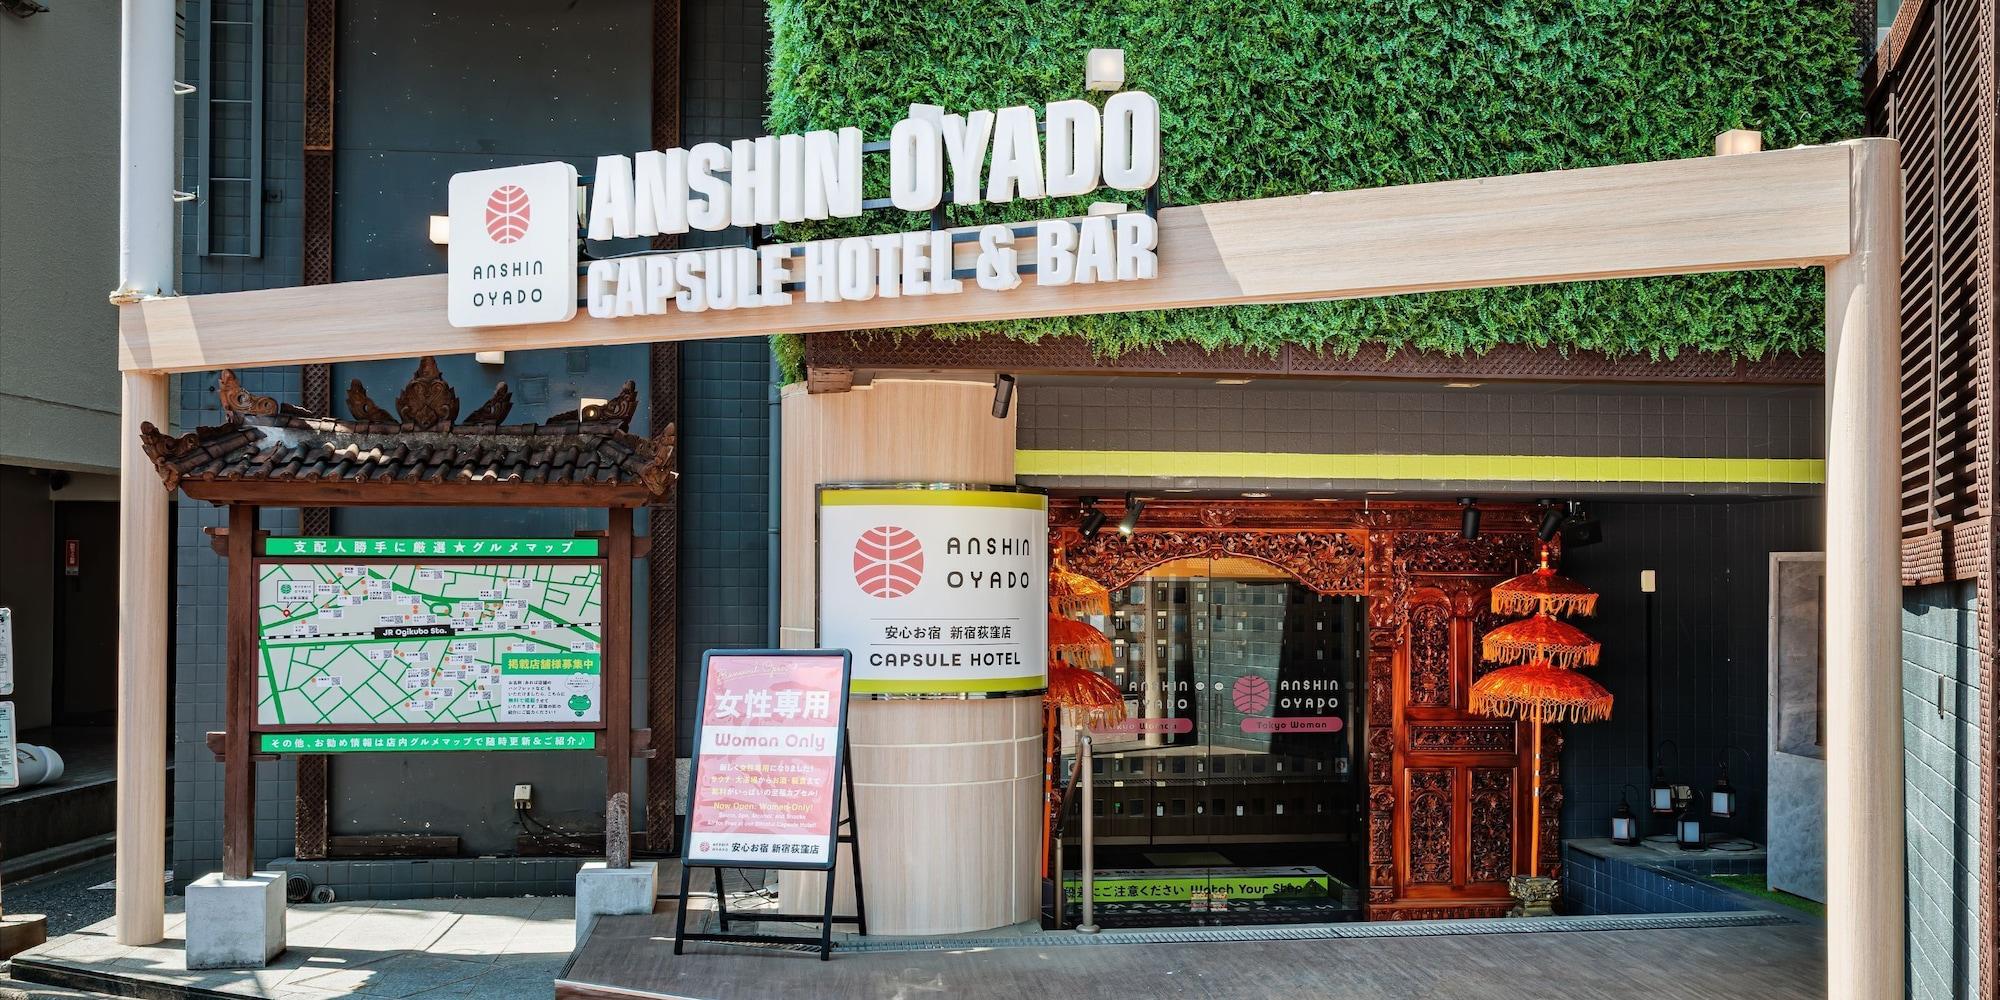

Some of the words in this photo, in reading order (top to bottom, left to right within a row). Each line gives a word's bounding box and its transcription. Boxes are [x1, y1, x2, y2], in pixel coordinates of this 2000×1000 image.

[588, 126, 863, 241] ANSHIN
[889, 90, 1160, 212] OYADO
[472, 260, 543, 281] ANSHIN
[587, 244, 794, 319] CAPSULE
[805, 230, 963, 304] HOTEL
[976, 224, 1021, 292] &
[1036, 213, 1158, 287] BAR
[472, 287, 543, 307] OYADO
[947, 537, 1030, 556] ANSHIN
[947, 571, 1030, 589] OYADO
[383, 629, 394, 637] JR
[395, 628, 429, 638] Ogikubo
[430, 626, 447, 635] Sta.
[885, 625, 941, 640] 安心お宿
[950, 625, 1012, 640] 新宿荻窪店
[869, 653, 962, 667] CAPSULE
[970, 652, 1021, 667] HOTEL
[1129, 681, 1188, 691] ANHIN
[1280, 679, 1339, 691] ANSHIN
[715, 689, 830, 719] 女性専用
[1280, 698, 1339, 709] OYADO
[1257, 722, 1287, 731] Tokyo
[715, 733, 779, 748] Woman
[785, 733, 826, 751] Only
[713, 802, 731, 810] Now
[731, 842, 769, 853] 安心お宿
[771, 843, 820, 854] 新宿荻窪店
[1190, 884, 1234, 894] Watch
[1238, 884, 1269, 894] Your
